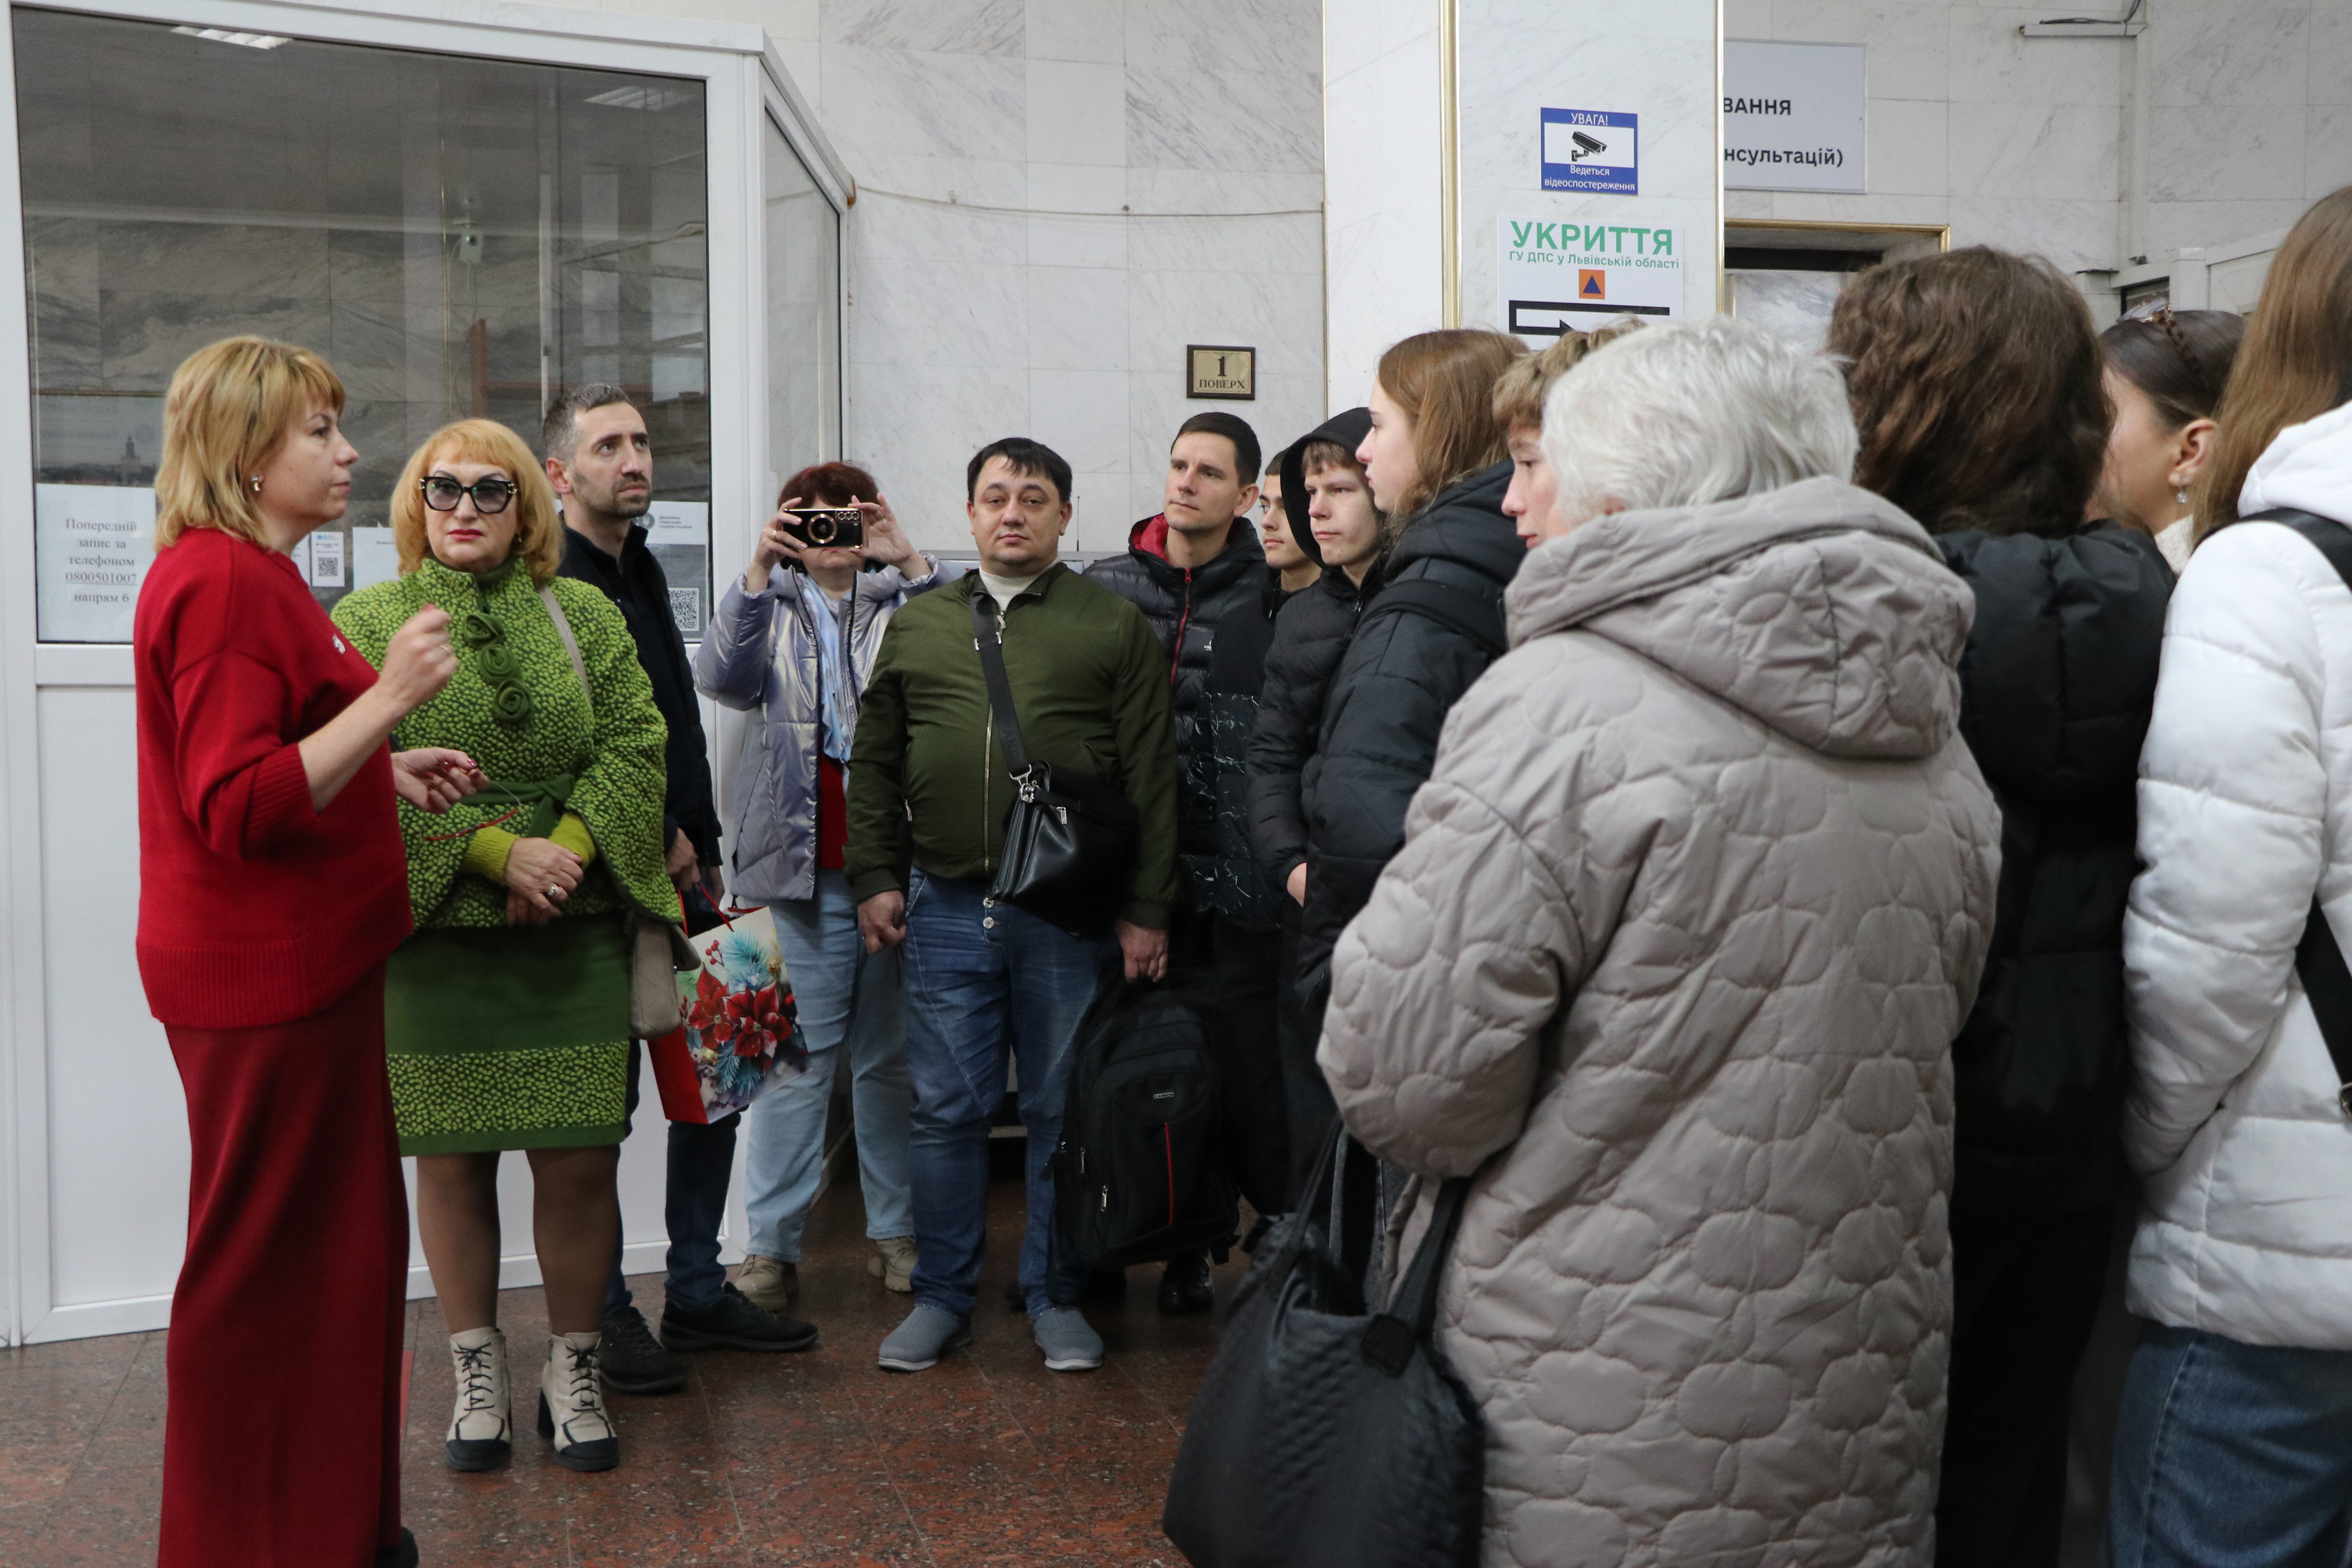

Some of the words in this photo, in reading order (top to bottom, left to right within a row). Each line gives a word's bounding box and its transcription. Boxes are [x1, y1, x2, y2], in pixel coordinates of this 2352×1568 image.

[1724, 98, 1791, 115] ВАННЯ
[1571, 113, 1608, 125] УВАГА!
[1724, 148, 1843, 167] нсультацій)
[1570, 165, 1610, 176] Ведеться
[1544, 178, 1635, 191] відеоспостереження
[1510, 221, 1672, 255] УКРИТТЯ
[1510, 251, 1524, 261] ГУ
[1528, 252, 1553, 263] ДПС
[1557, 255, 1564, 265] у
[1568, 254, 1631, 267] Львівській
[1635, 258, 1679, 269] області
[1217, 356, 1227, 376] 1
[1200, 379, 1245, 388] ПОВЕРХ
[65, 518, 137, 532] Попередній
[78, 539, 111, 548] запис
[69, 555, 134, 567] телефоном
[65, 572, 137, 583] 0800501007
[74, 593, 118, 604] напрям
[122, 593, 129, 602] 6
